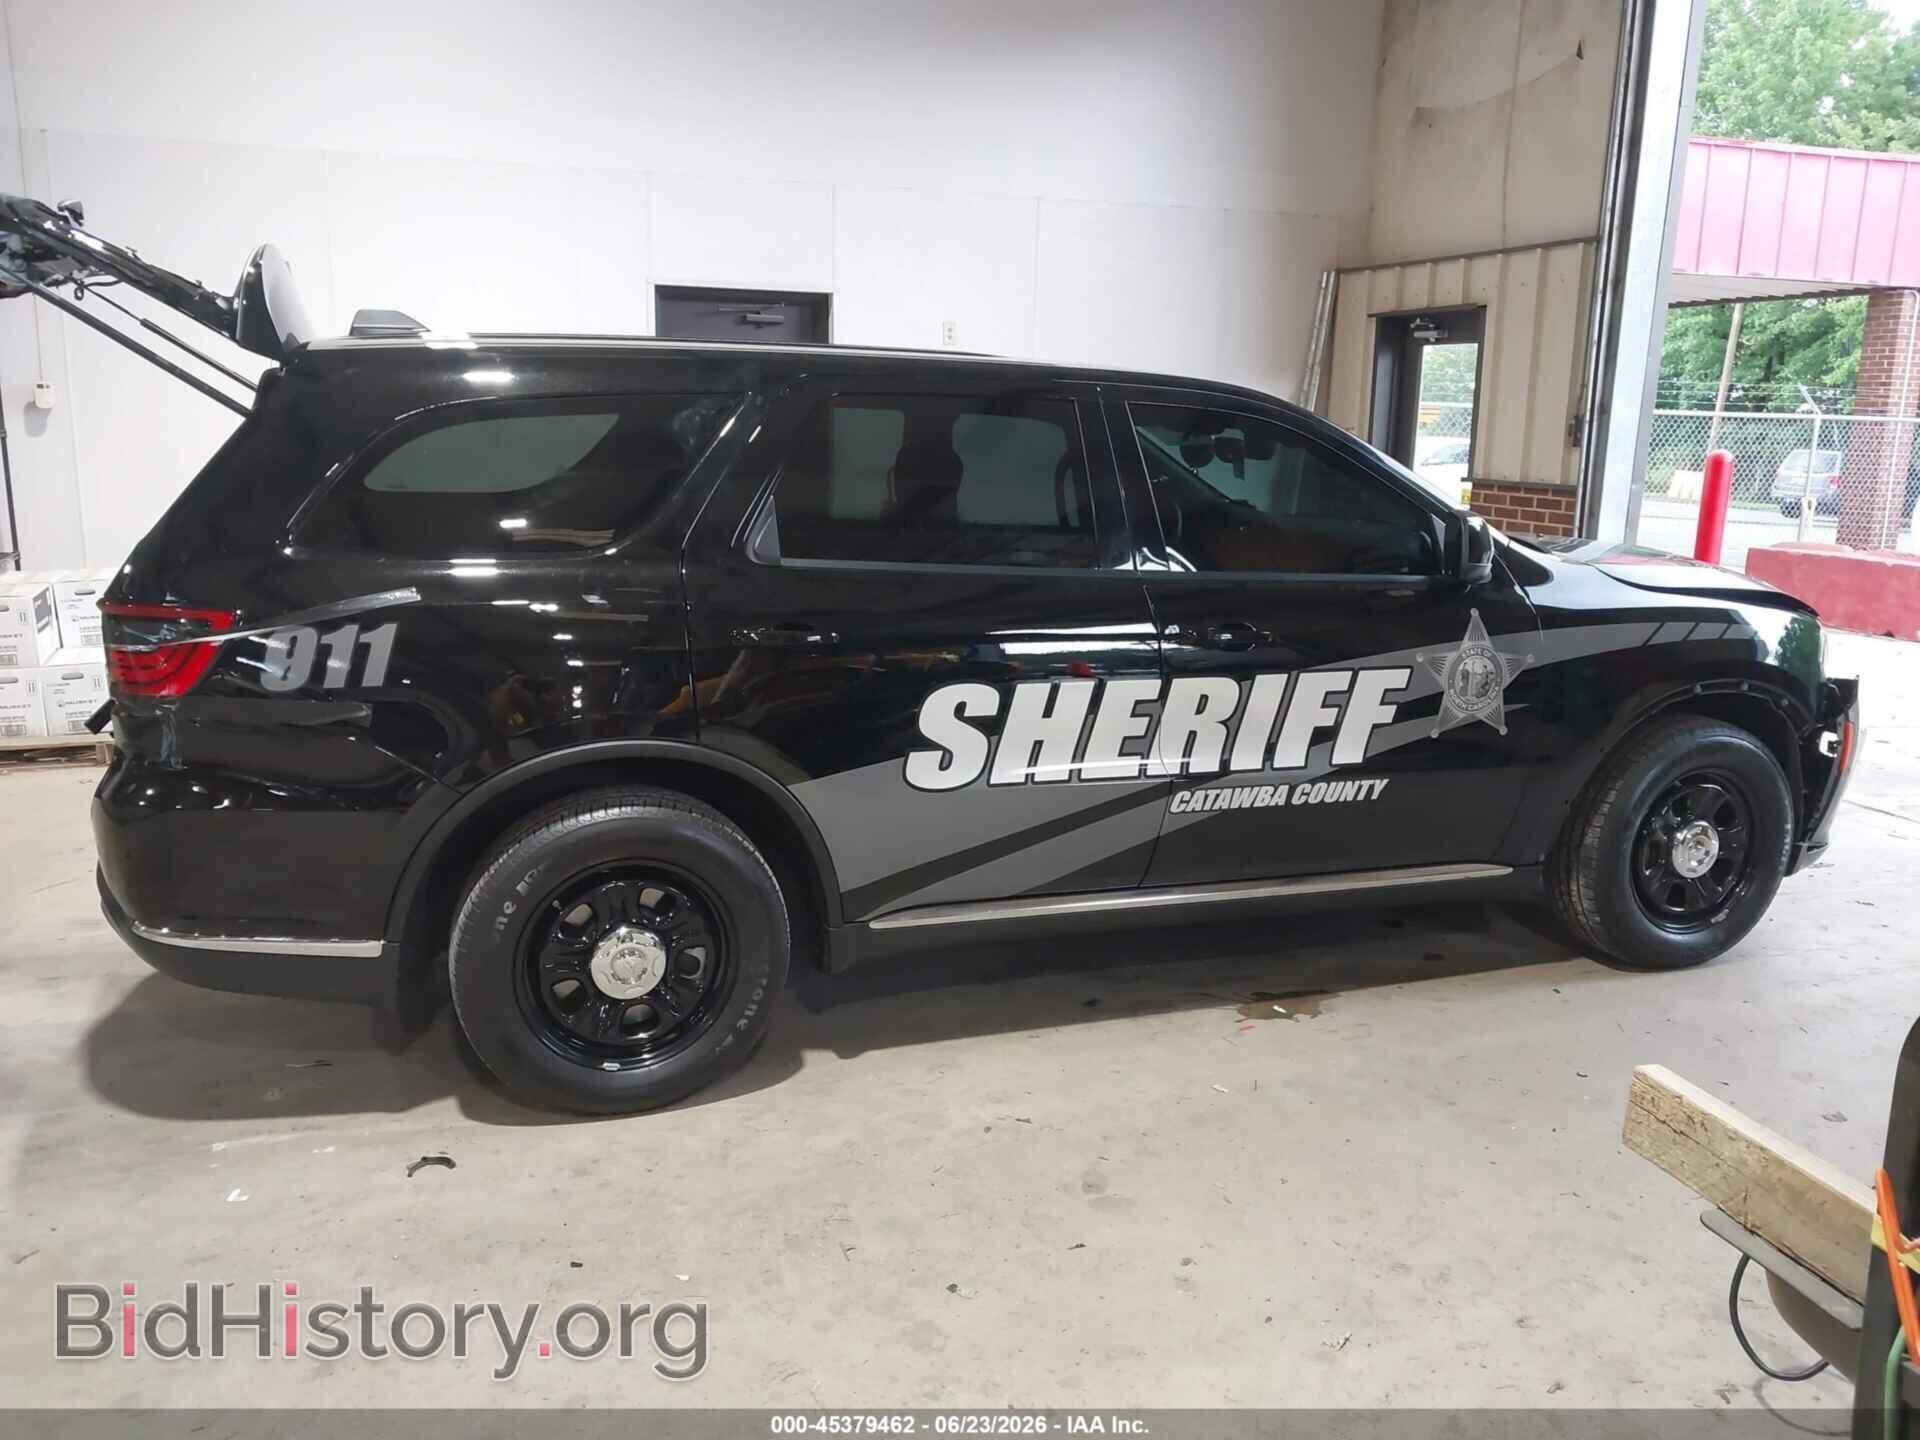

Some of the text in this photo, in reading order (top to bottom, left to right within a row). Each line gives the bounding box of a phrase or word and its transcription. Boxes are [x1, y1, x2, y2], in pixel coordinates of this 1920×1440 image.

[260, 623, 398, 692] 911
[903, 667, 1412, 792] SHERIFF
[1169, 778, 1390, 814] CATAWBA COUNTY
